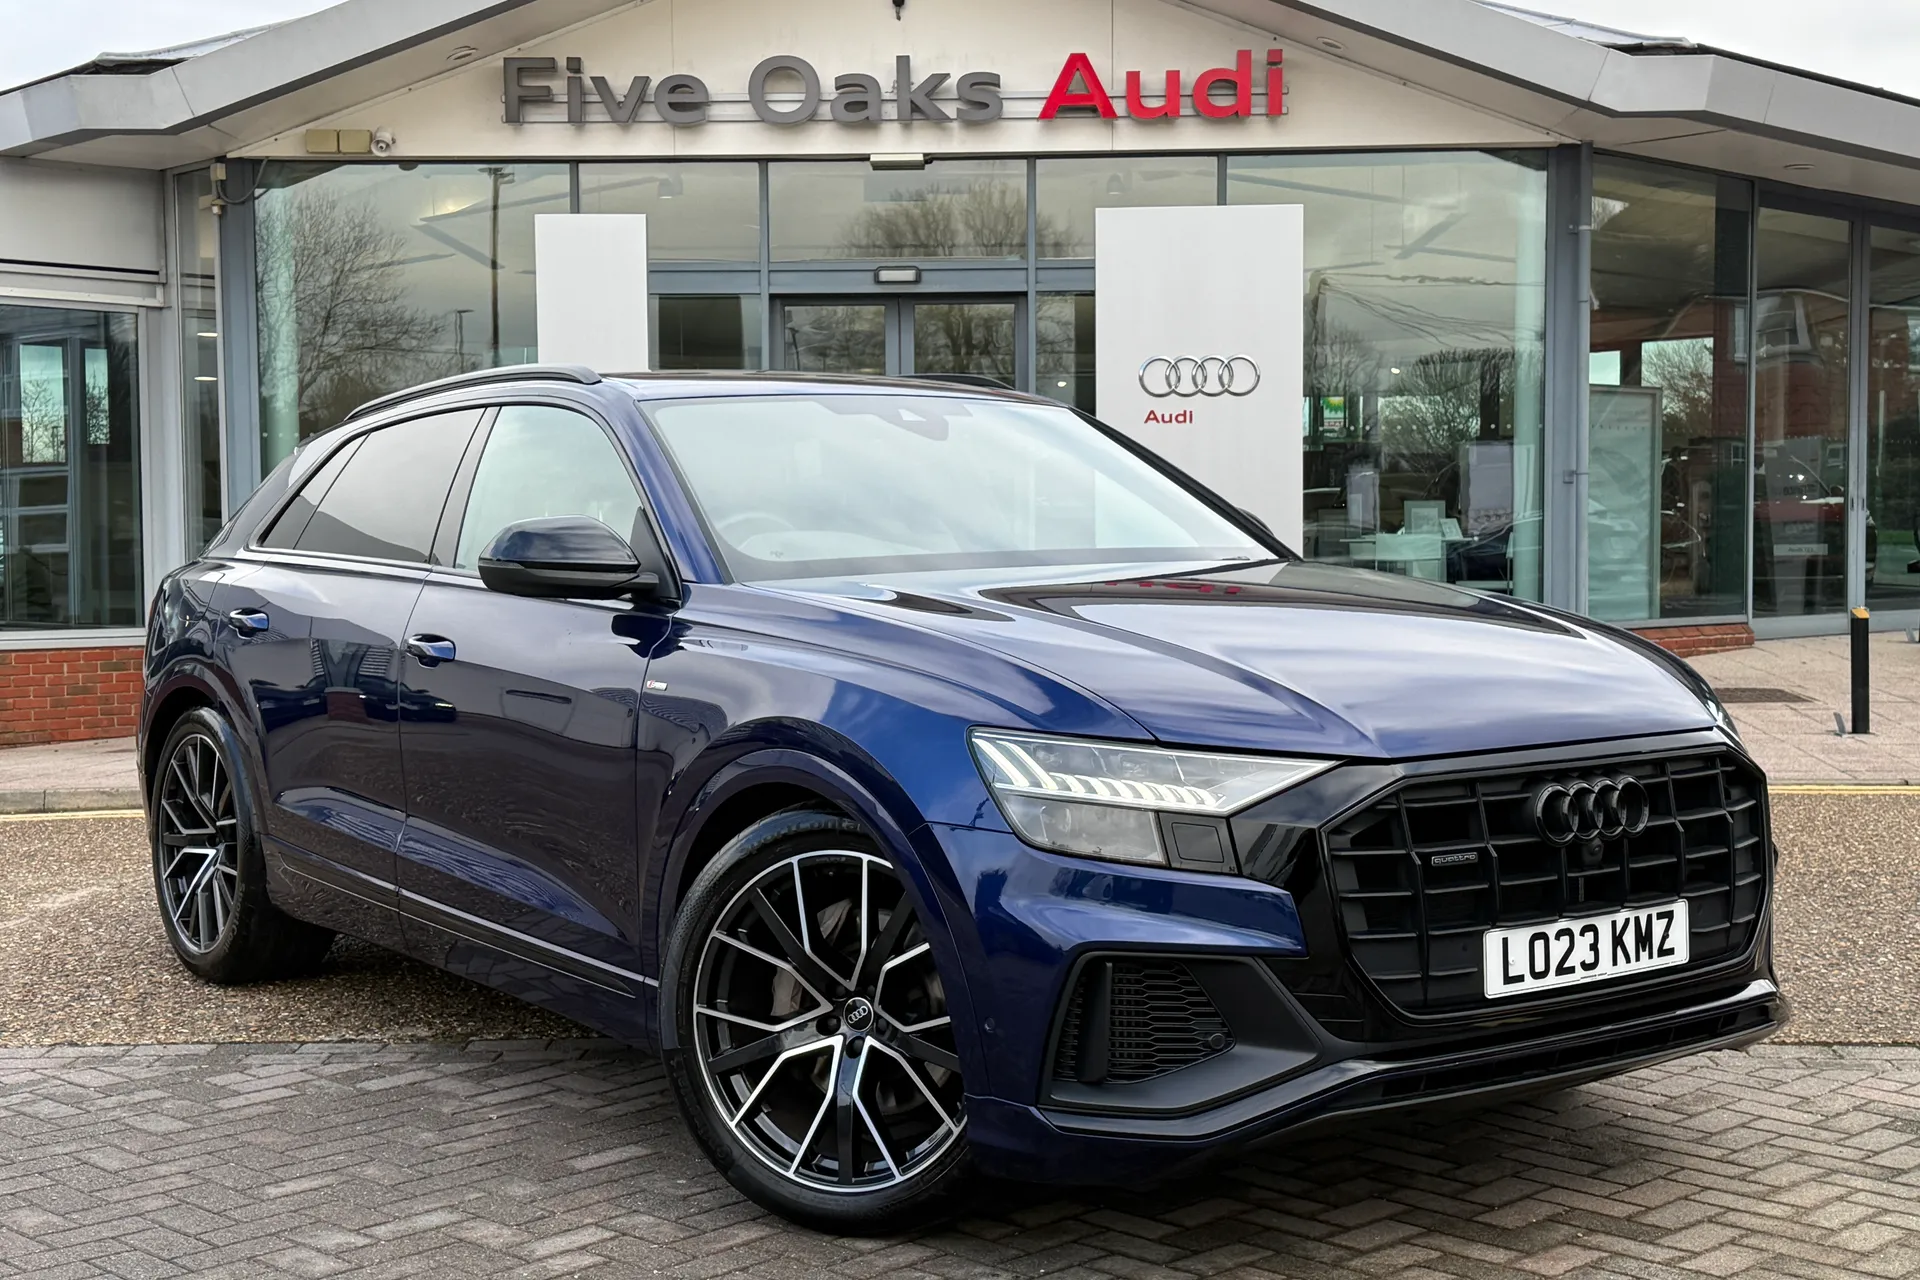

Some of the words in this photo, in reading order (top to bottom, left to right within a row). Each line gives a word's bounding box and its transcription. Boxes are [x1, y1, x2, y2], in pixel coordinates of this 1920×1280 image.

[503, 57, 709, 124] Five
[748, 55, 1003, 125] Oaks
[1038, 49, 1283, 120] Audi
[1143, 409, 1193, 424] Audi
[1433, 854, 1476, 865] quattro
[1502, 923, 1600, 986] LO23
[1611, 909, 1675, 967] KMZ
